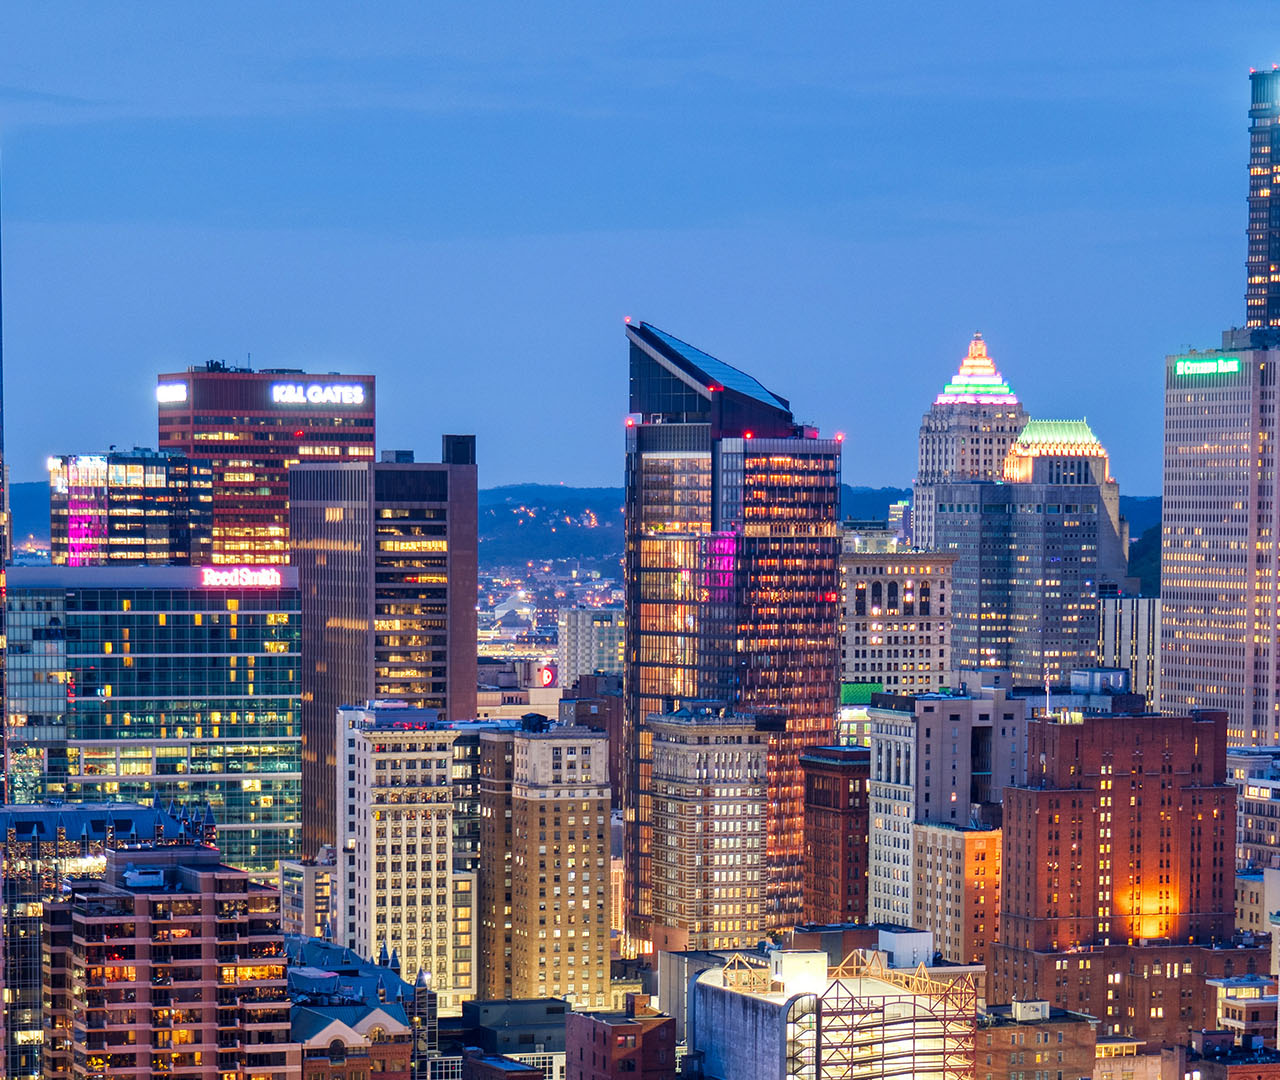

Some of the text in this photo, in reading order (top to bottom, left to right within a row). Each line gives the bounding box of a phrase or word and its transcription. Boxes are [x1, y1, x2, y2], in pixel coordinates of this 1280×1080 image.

[273, 384, 365, 404] K&L GATES
[202, 567, 281, 586] Reed Smith
